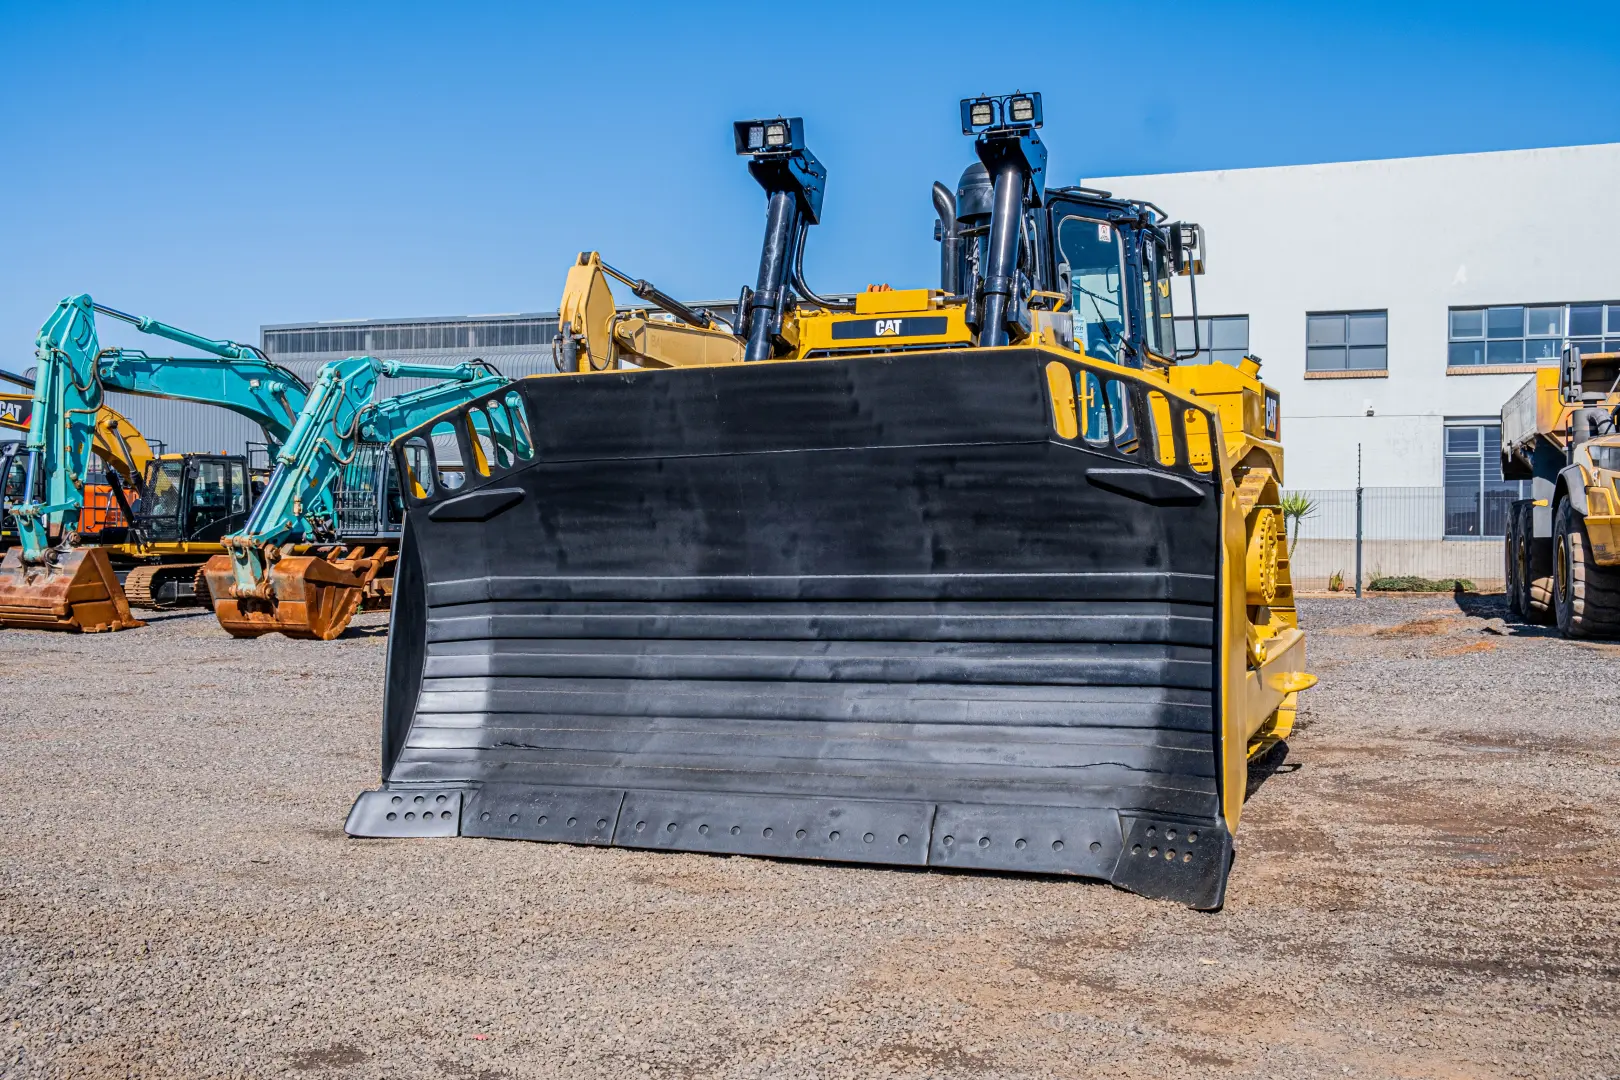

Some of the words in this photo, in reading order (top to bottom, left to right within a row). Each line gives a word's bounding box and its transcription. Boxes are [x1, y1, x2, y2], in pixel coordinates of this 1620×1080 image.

[875, 319, 902, 336] CAT
[0, 400, 22, 422] CAT
[1266, 396, 1277, 432] CAT
